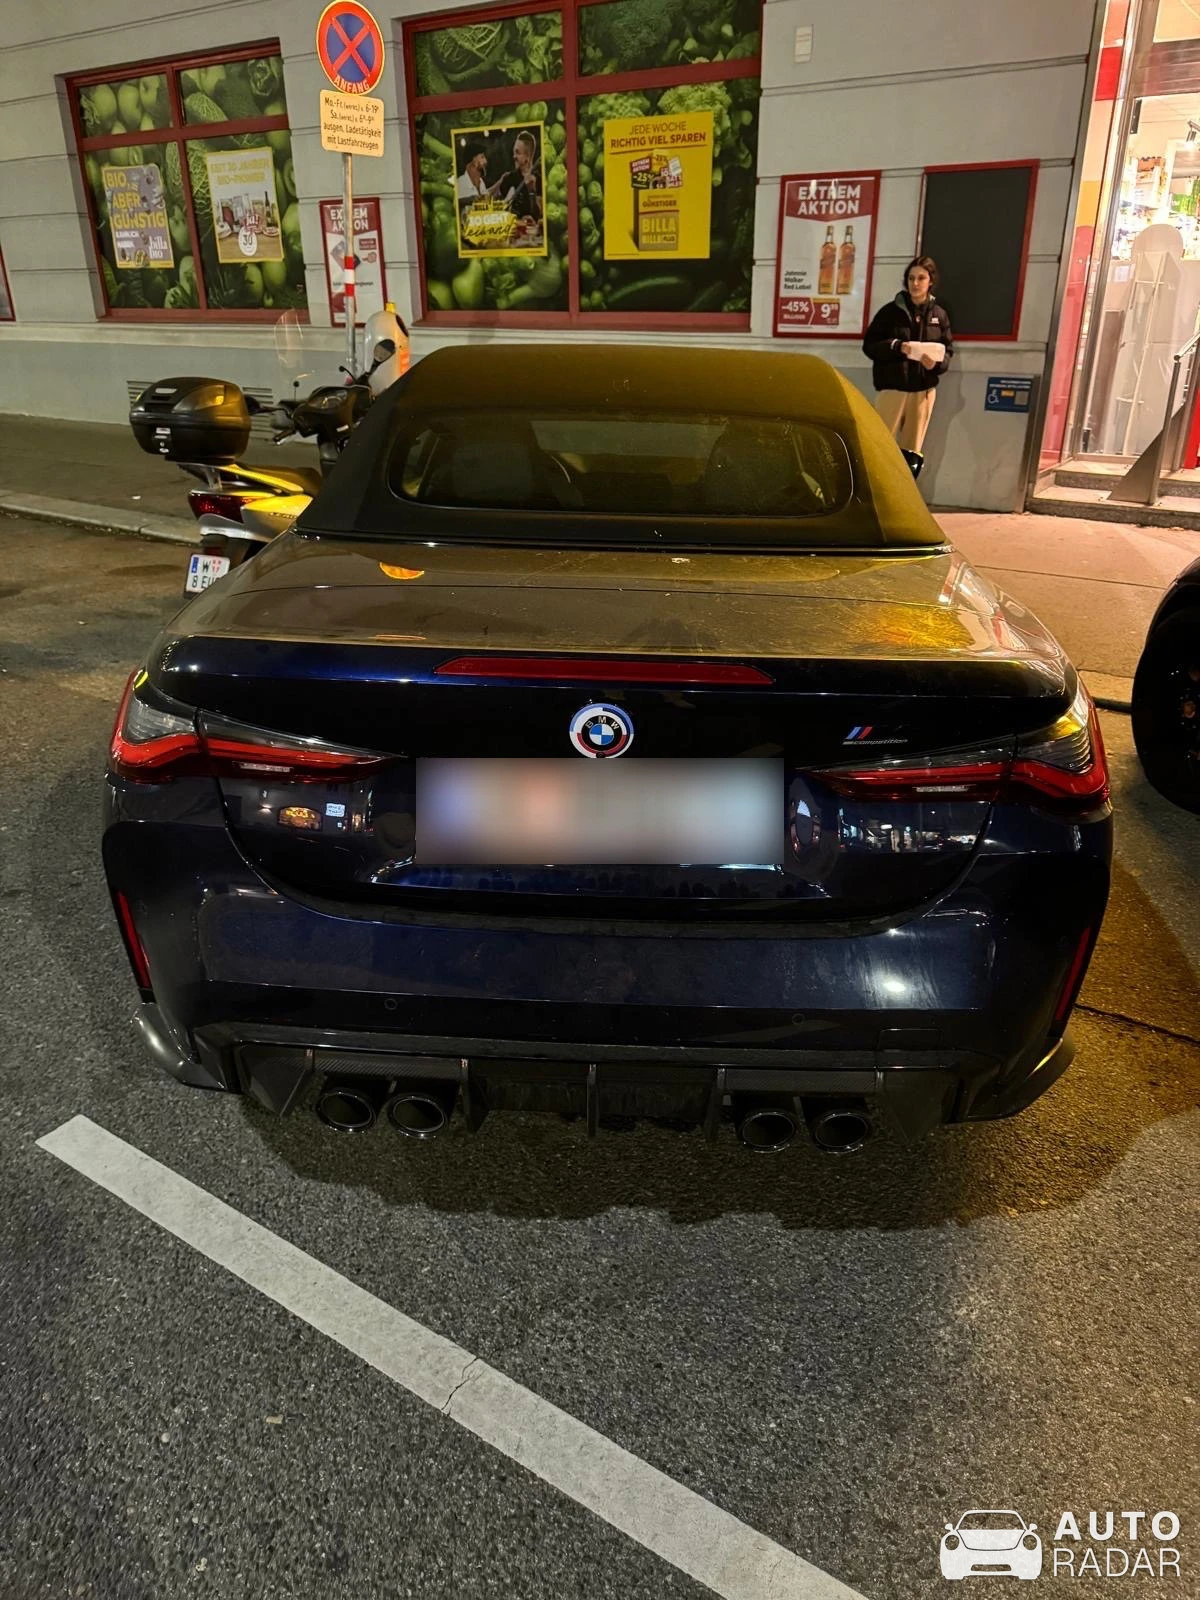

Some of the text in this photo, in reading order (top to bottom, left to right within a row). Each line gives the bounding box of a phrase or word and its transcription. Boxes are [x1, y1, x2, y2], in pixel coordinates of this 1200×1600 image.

[334, 75, 370, 94] ANFANG
[345, 124, 382, 138] Ladetätigkeit
[629, 121, 687, 135] JEDE WOCHE
[327, 134, 379, 151] mit Lastfahrzeugen
[610, 131, 706, 149] RICHTIG VIEL SPAREN
[798, 184, 861, 200] EXTREM
[112, 191, 141, 209] ABER
[797, 199, 860, 215] AKTION
[113, 208, 165, 229] GÜNSTIG
[330, 207, 368, 220] EXEM
[332, 219, 368, 231] AKON
[642, 217, 676, 233] BILLA
[781, 300, 810, 313] -45%
[203, 560, 211, 573] W
[192, 575, 198, 588] 8
[585, 716, 620, 729] BMW
